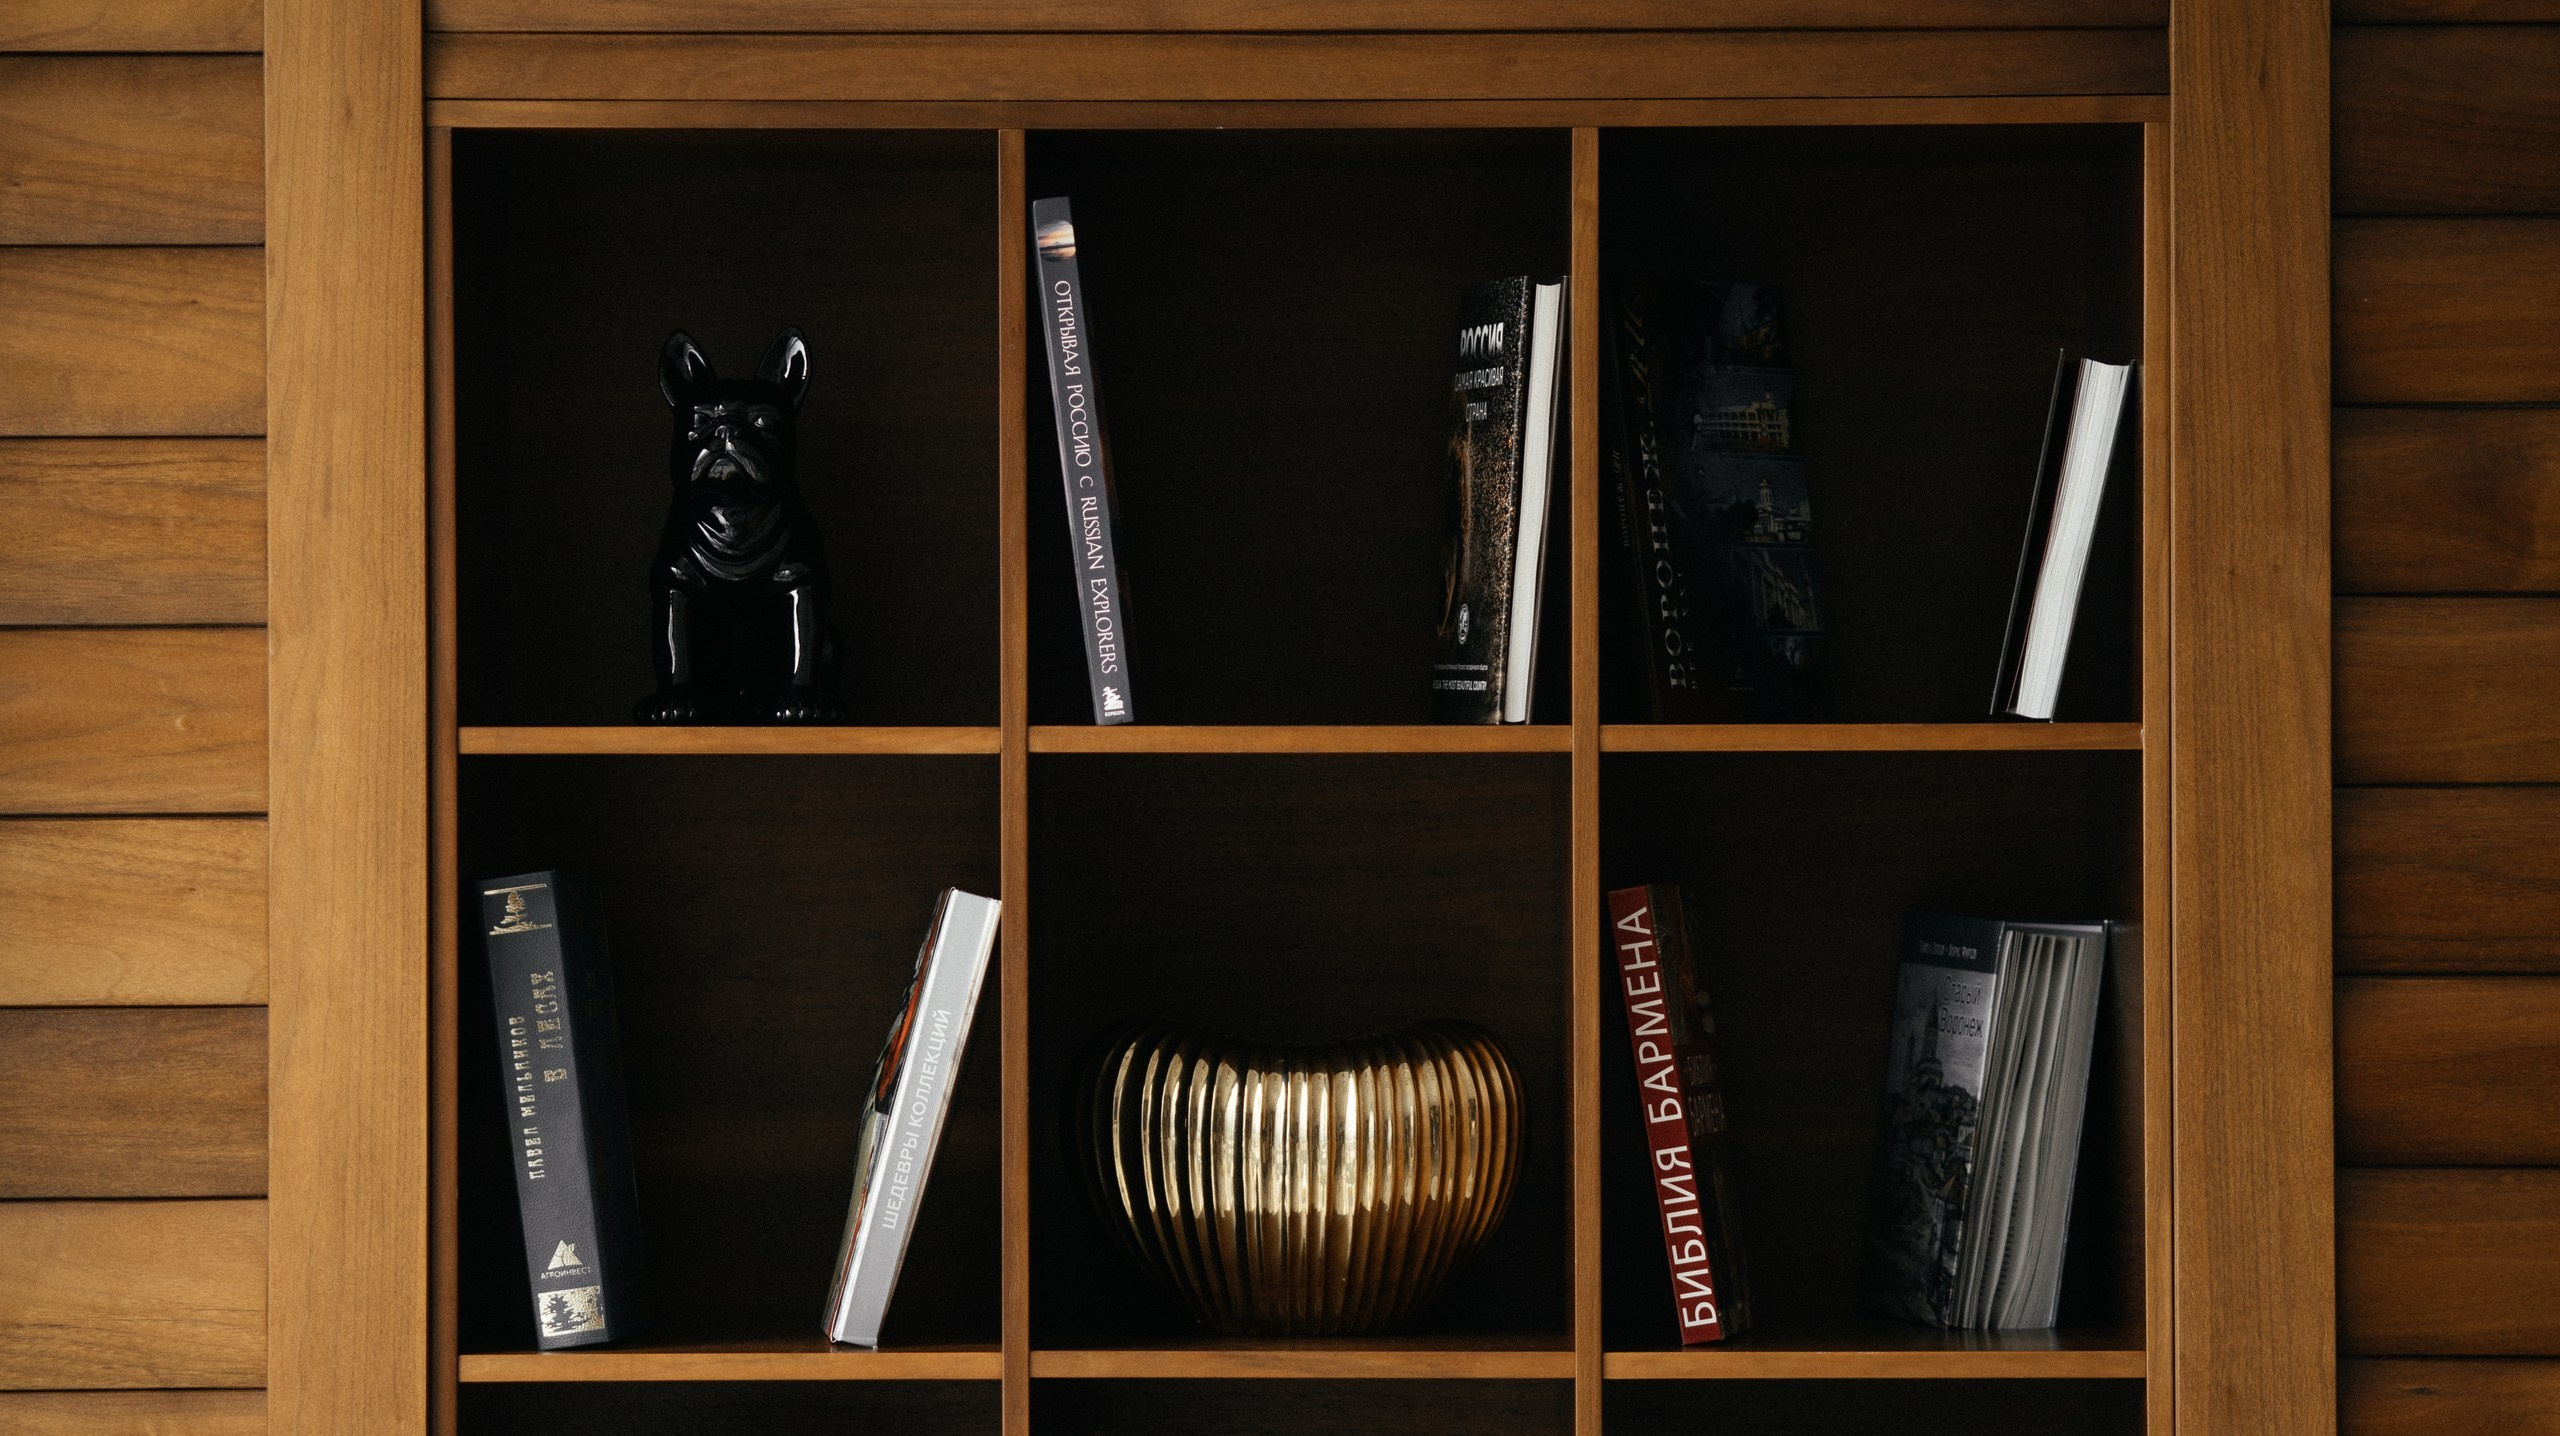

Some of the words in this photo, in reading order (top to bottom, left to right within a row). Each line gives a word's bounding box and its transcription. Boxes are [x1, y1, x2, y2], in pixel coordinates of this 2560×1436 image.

[1054, 280, 1081, 376] ОТКРЫВАЯ
[1459, 322, 1504, 361] РОССИЯ
[1067, 384, 1092, 467] РОССИЮ
[1081, 496, 1105, 570] RUSSIAN
[1091, 578, 1118, 674] EXPLORERS
[1616, 905, 1683, 1124] БАРМЕНА
[1939, 1007, 1984, 1040] Воронеж
[508, 1016, 537, 1118] МЕЛЬНИКОВ
[543, 1068, 568, 1083] В
[881, 1130, 920, 1230] ШЕДЕВРЫ
[908, 1008, 951, 1129] КОЛЛЕКЦИЙ
[540, 1266, 591, 1280] АГРОИНВЕСТ
[1655, 1144, 1718, 1329] БИБЛИЯ
